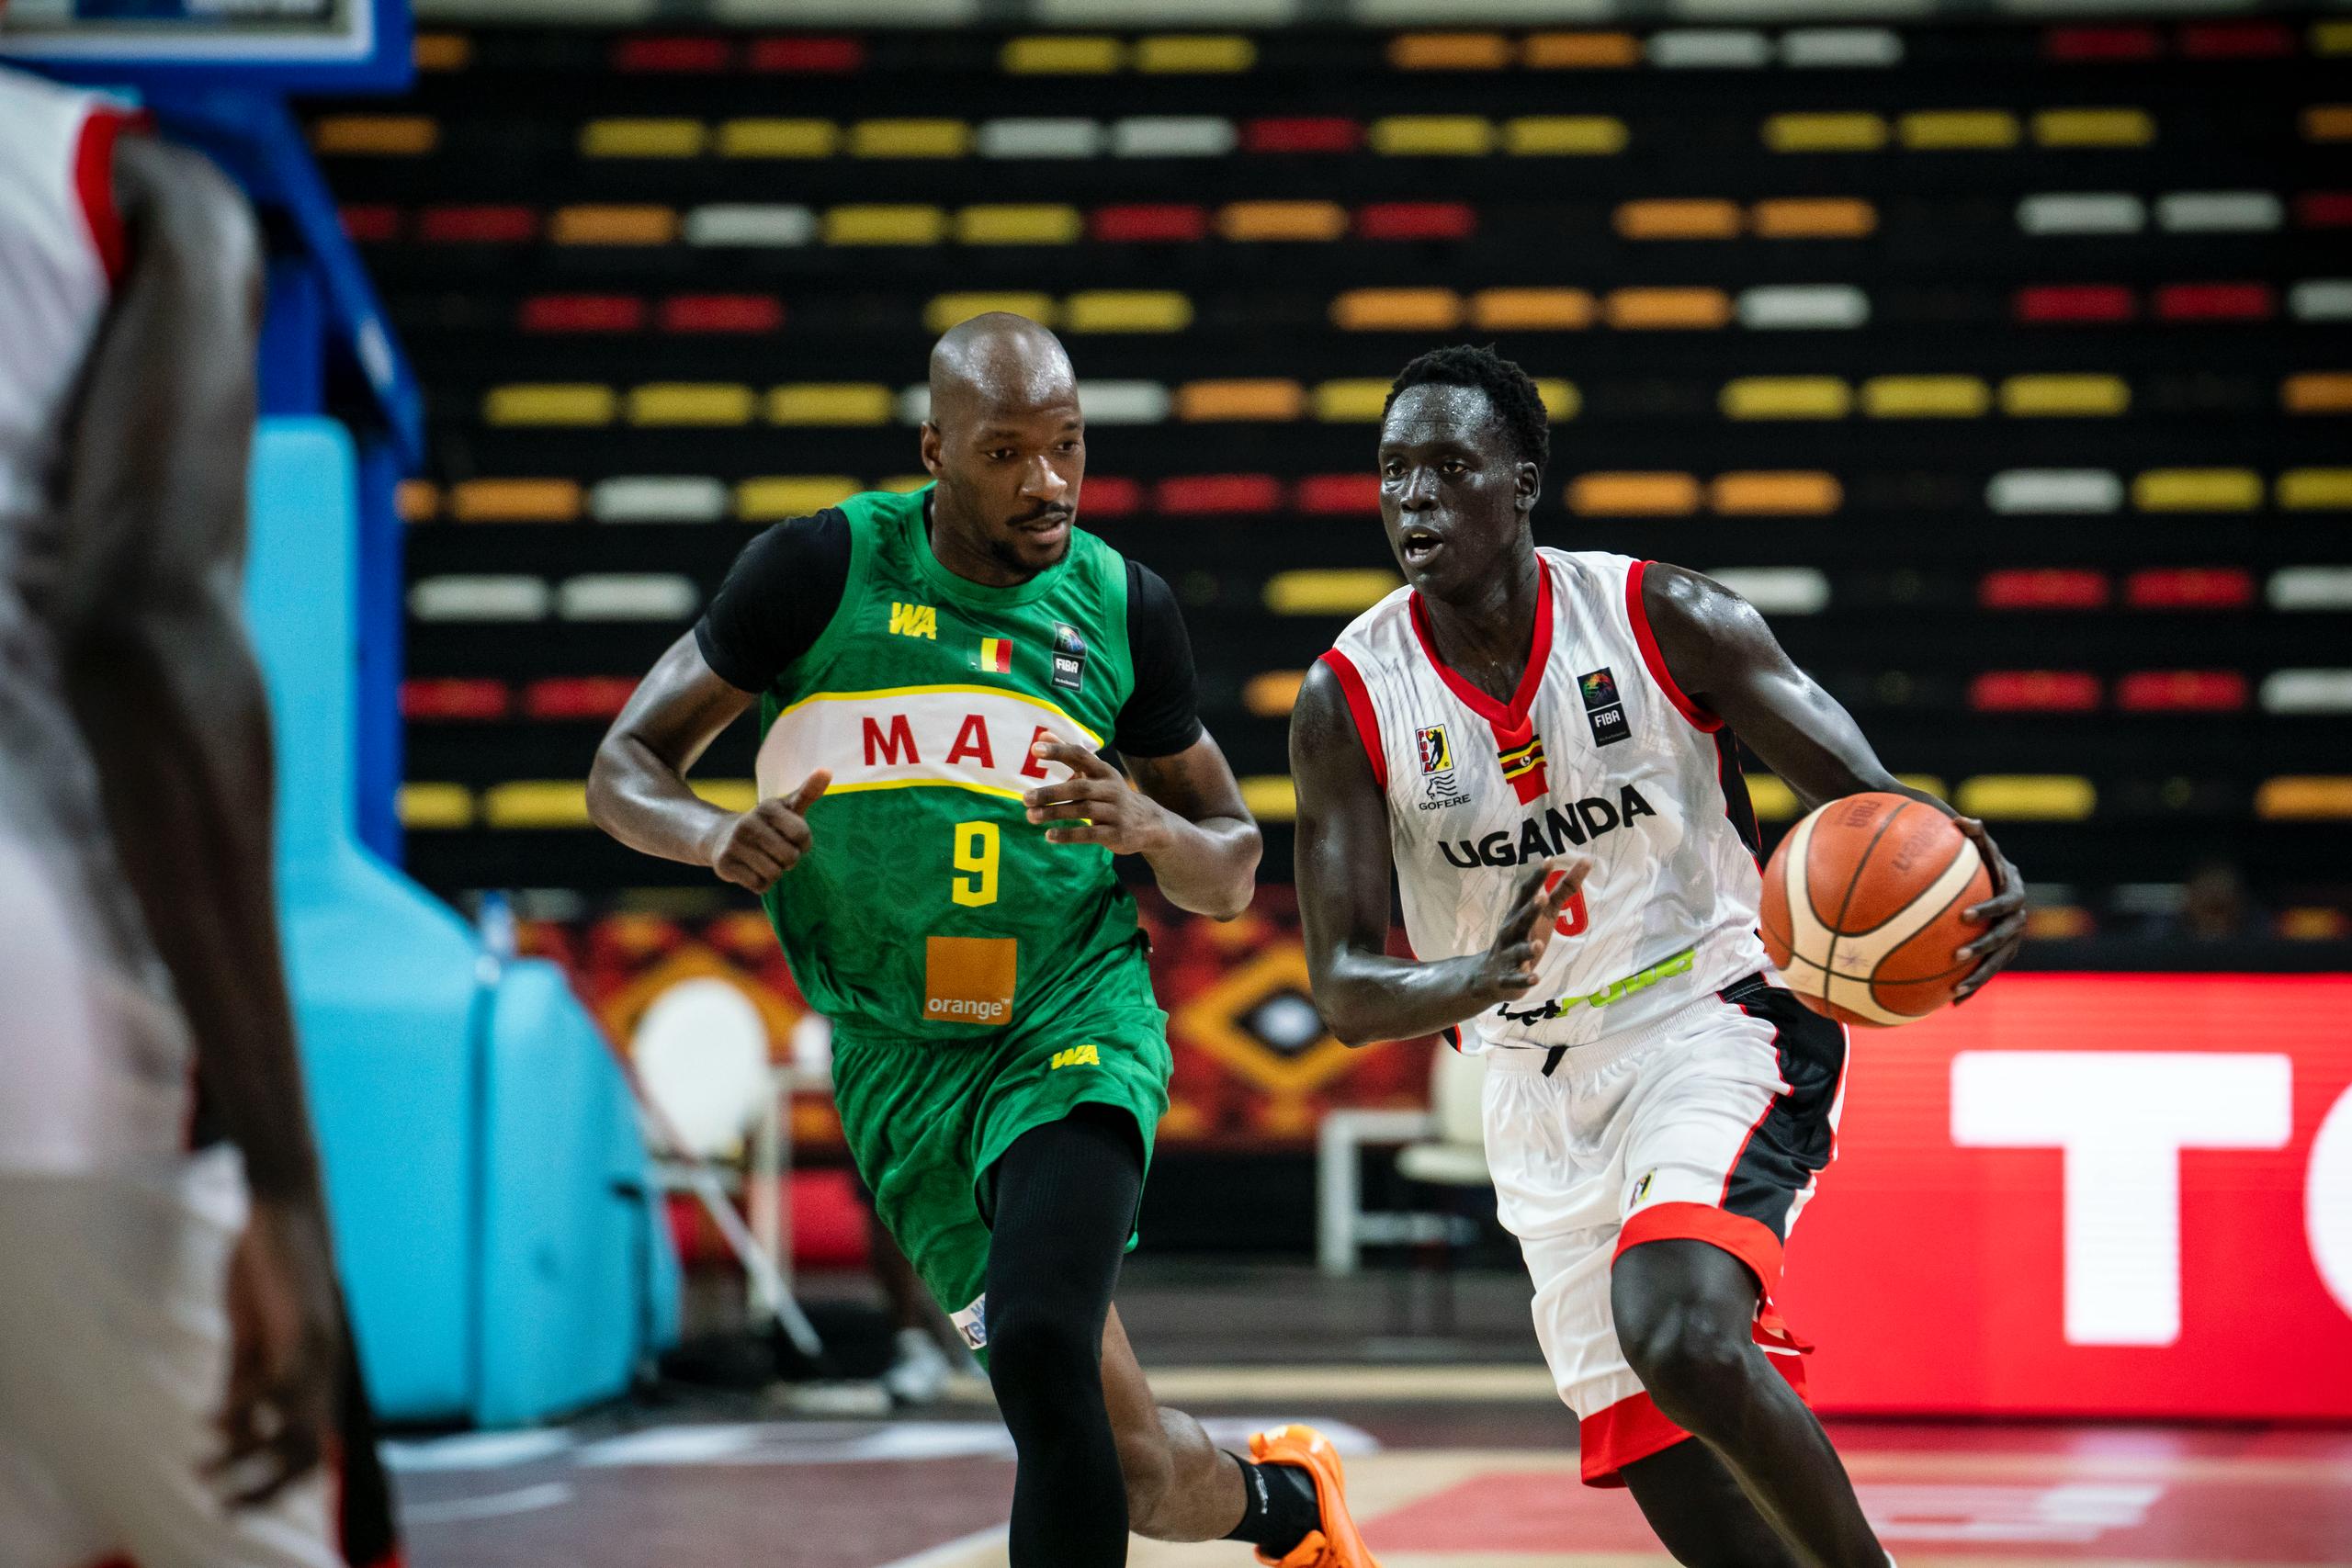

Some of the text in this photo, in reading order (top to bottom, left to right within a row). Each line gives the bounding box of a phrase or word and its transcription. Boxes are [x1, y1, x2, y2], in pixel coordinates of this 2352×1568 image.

[1055, 657, 1080, 674] FIBA
[1594, 709, 1622, 728] FIBA
[862, 714, 1073, 780] MAL
[1419, 794, 1472, 811] GOFERE
[1438, 784, 1657, 868] UGANDA
[952, 820, 1001, 908] 9
[928, 998, 1003, 1021] orange
[1950, 1050, 2352, 1348] T
